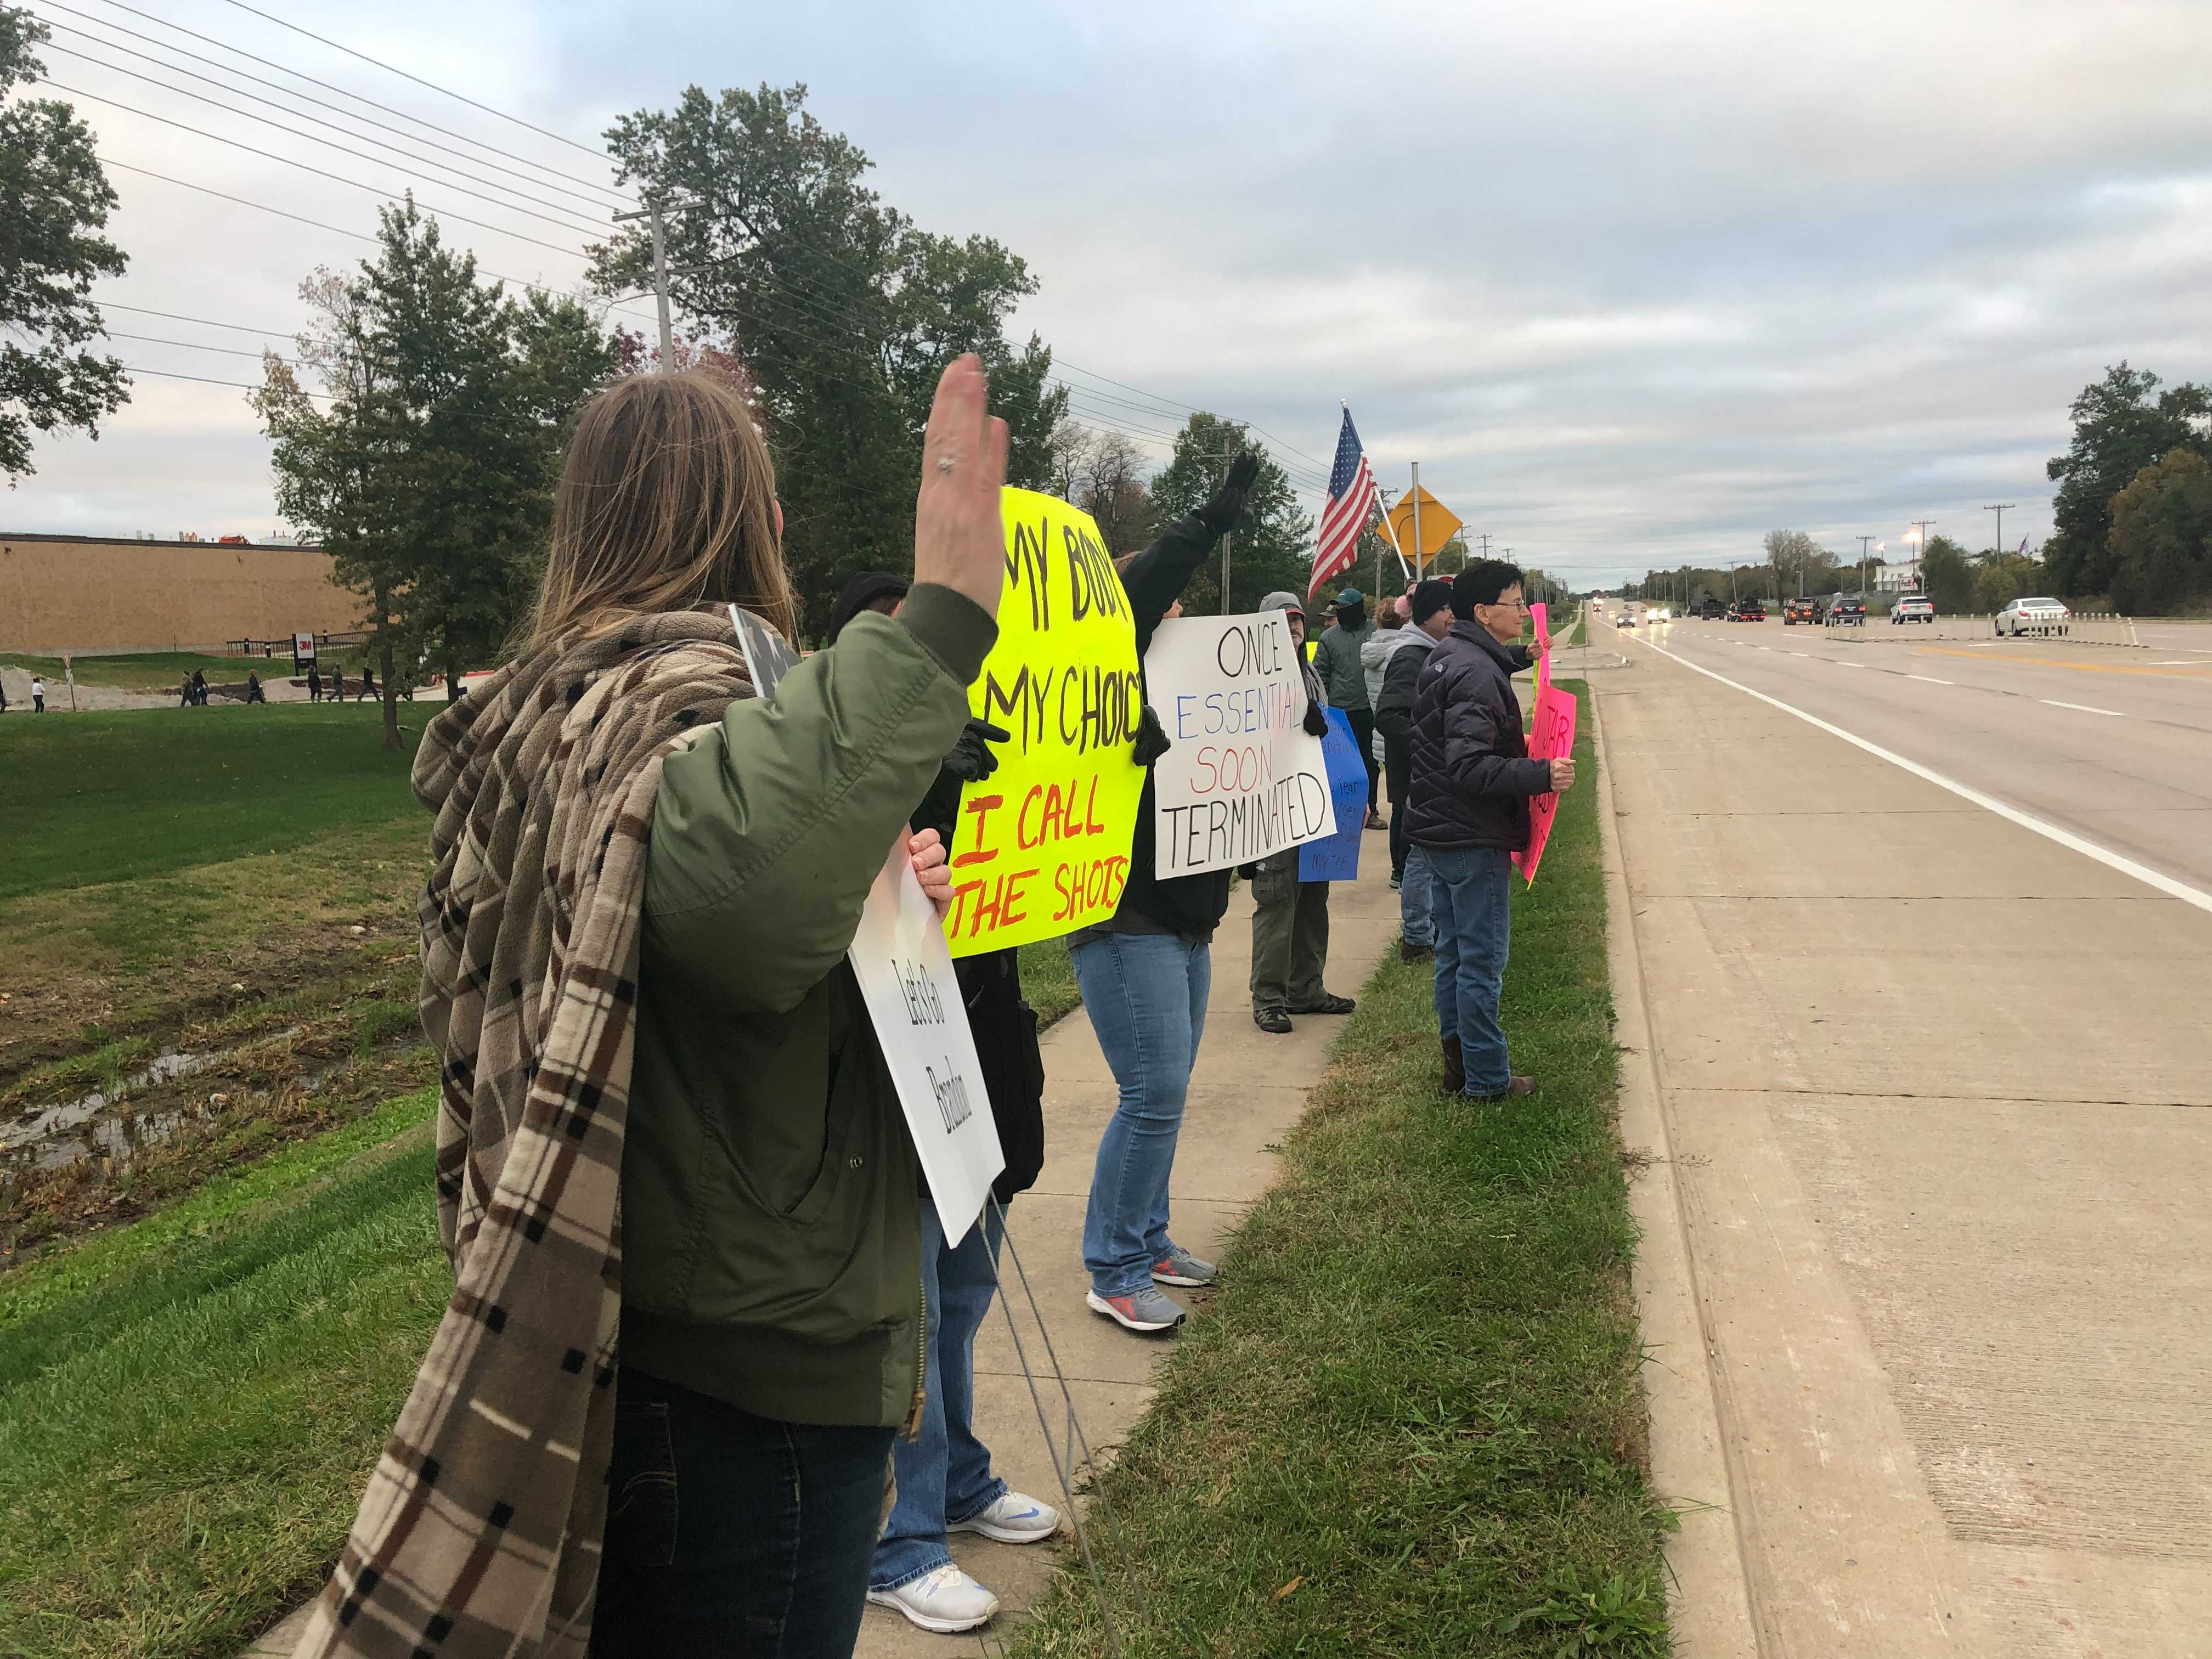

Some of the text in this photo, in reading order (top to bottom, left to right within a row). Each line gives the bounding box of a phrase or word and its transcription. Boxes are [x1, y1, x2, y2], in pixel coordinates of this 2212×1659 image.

[1005, 515, 1049, 632] MY
[299, 640, 312, 651] 3M
[1217, 621, 1282, 678] ONCE
[984, 663, 1144, 756] MY CHOIC
[1177, 678, 1301, 739] ESSENTIAL
[1190, 740, 1272, 794] SOON
[952, 774, 1104, 868] I CALL
[1161, 772, 1325, 869] TERMINATED
[950, 855, 1129, 939] THE SHOTS
[926, 1054, 973, 1135] Brandon
